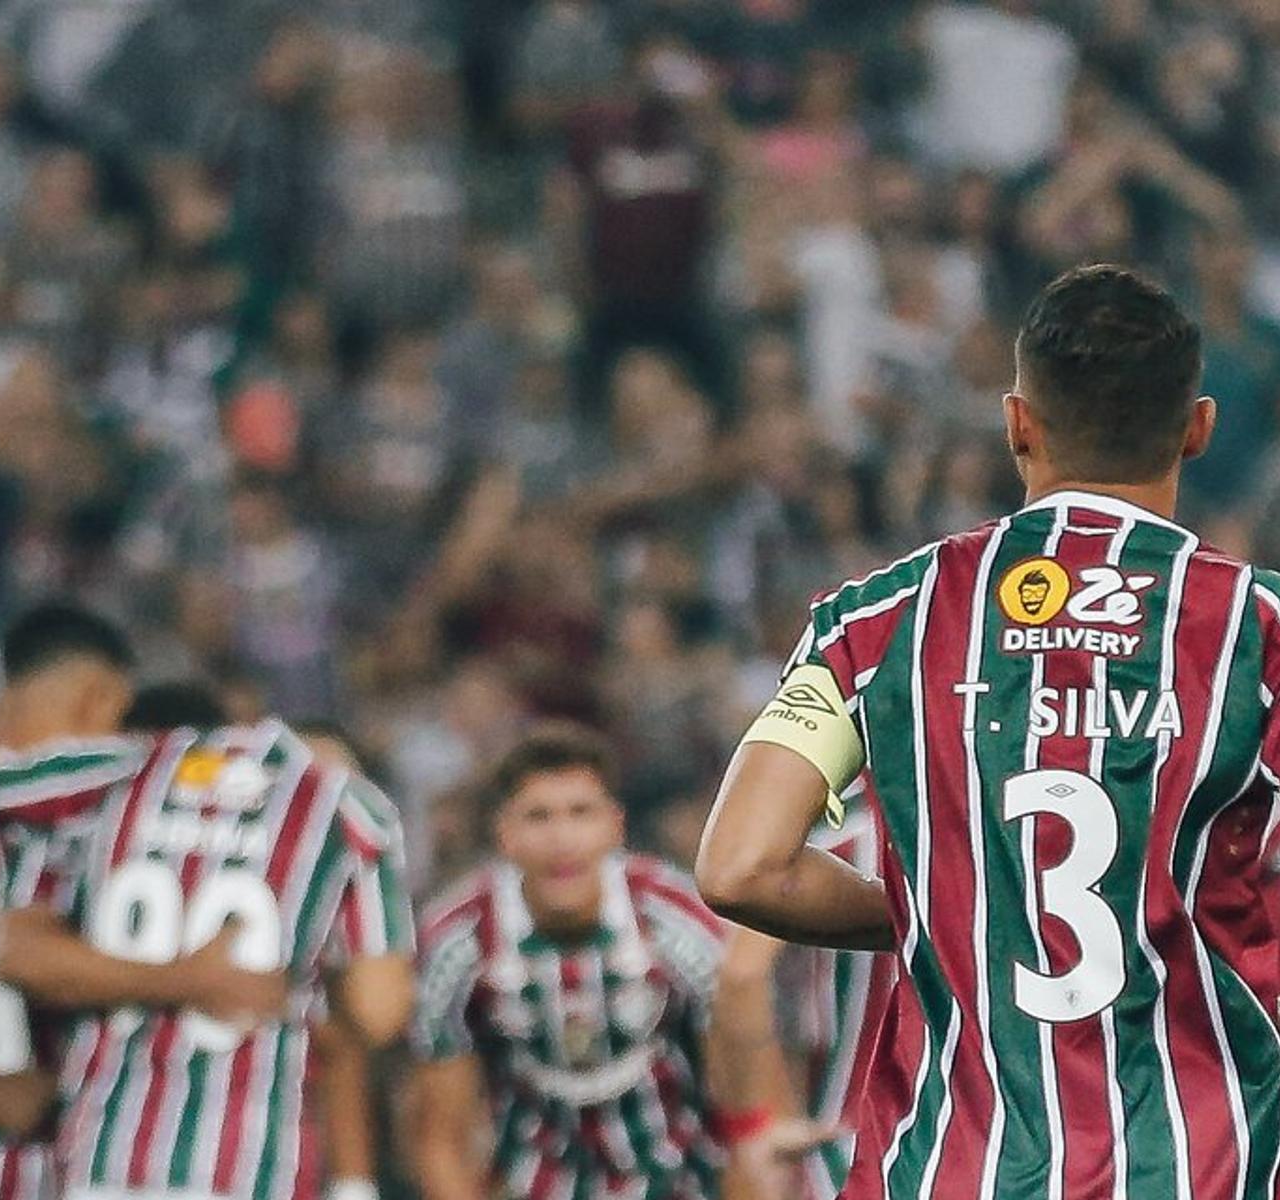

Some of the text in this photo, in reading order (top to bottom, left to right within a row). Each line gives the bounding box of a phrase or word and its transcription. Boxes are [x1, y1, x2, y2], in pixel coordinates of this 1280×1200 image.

[1066, 567, 1156, 625] Zé
[1003, 627, 1140, 655] DELIVERY
[762, 709, 818, 731] mbro
[953, 683, 1183, 738] T. SILVA
[1003, 769, 1127, 1023] 3
